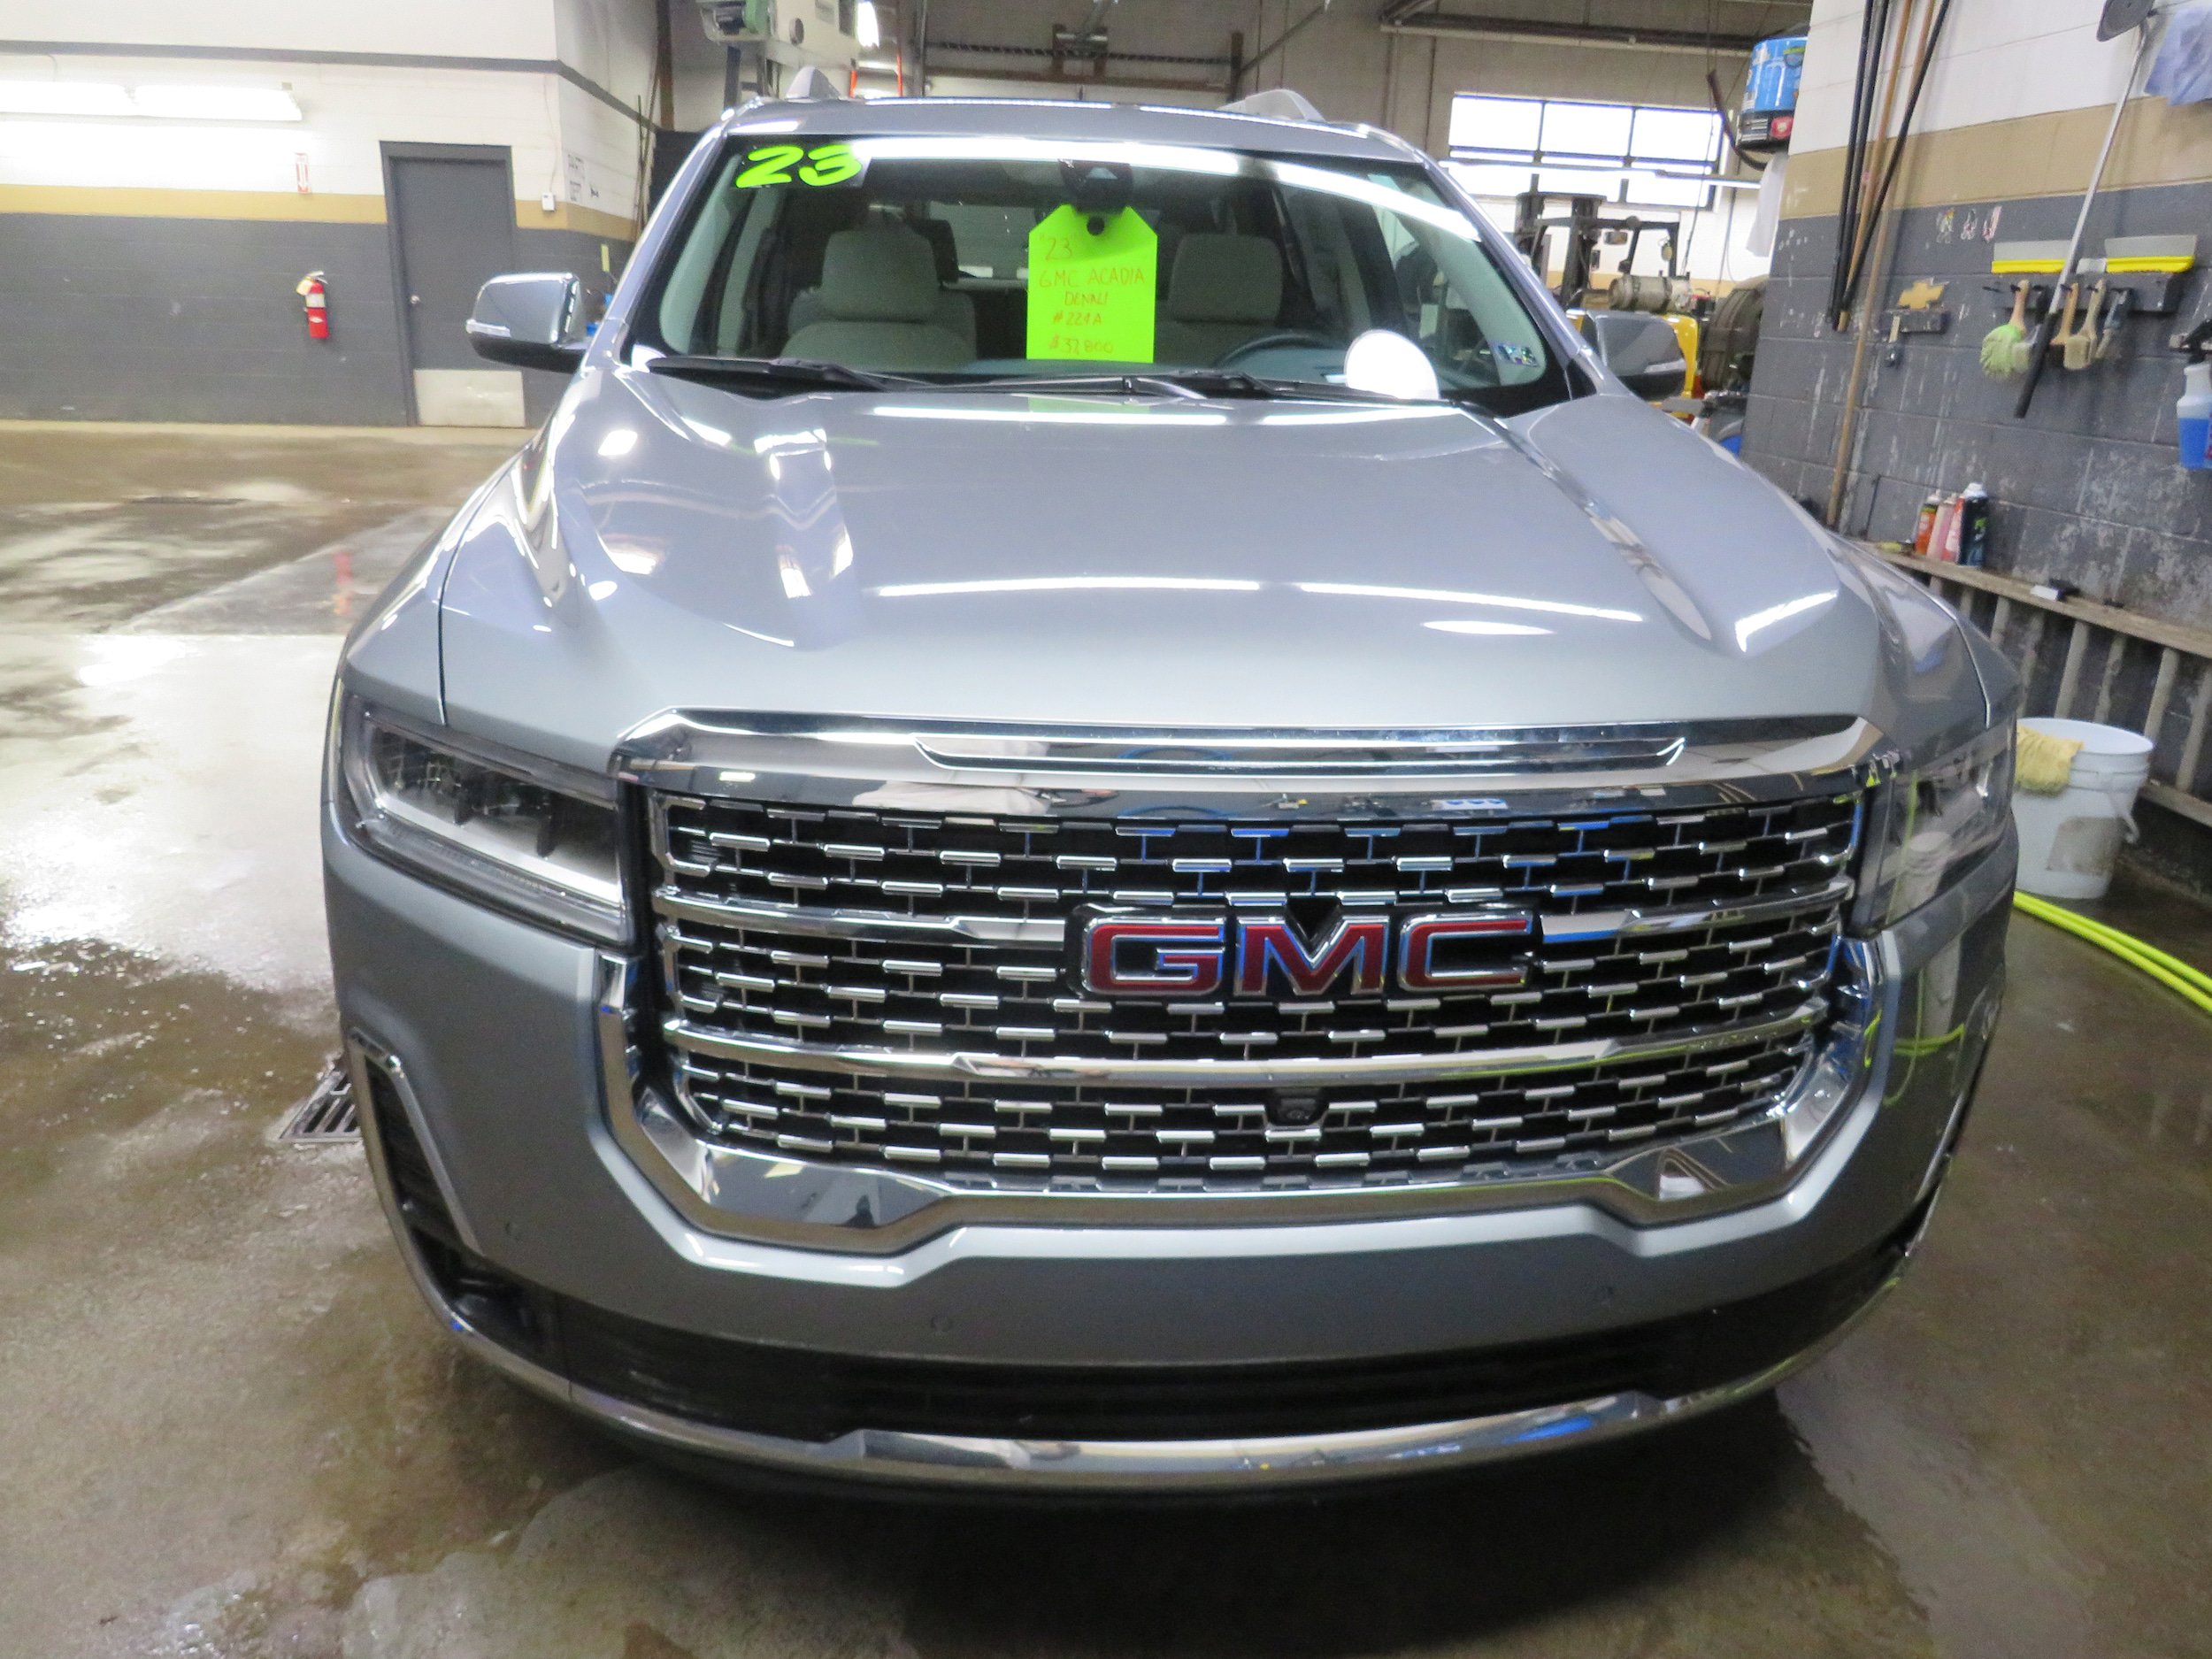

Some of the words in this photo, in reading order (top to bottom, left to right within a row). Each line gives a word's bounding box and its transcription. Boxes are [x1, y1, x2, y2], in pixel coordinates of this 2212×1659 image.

[735, 144, 863, 188] 23
[1039, 269, 1079, 288] GMC
[1088, 267, 1145, 285] ACADIA
[1081, 910, 1533, 997] GMC
